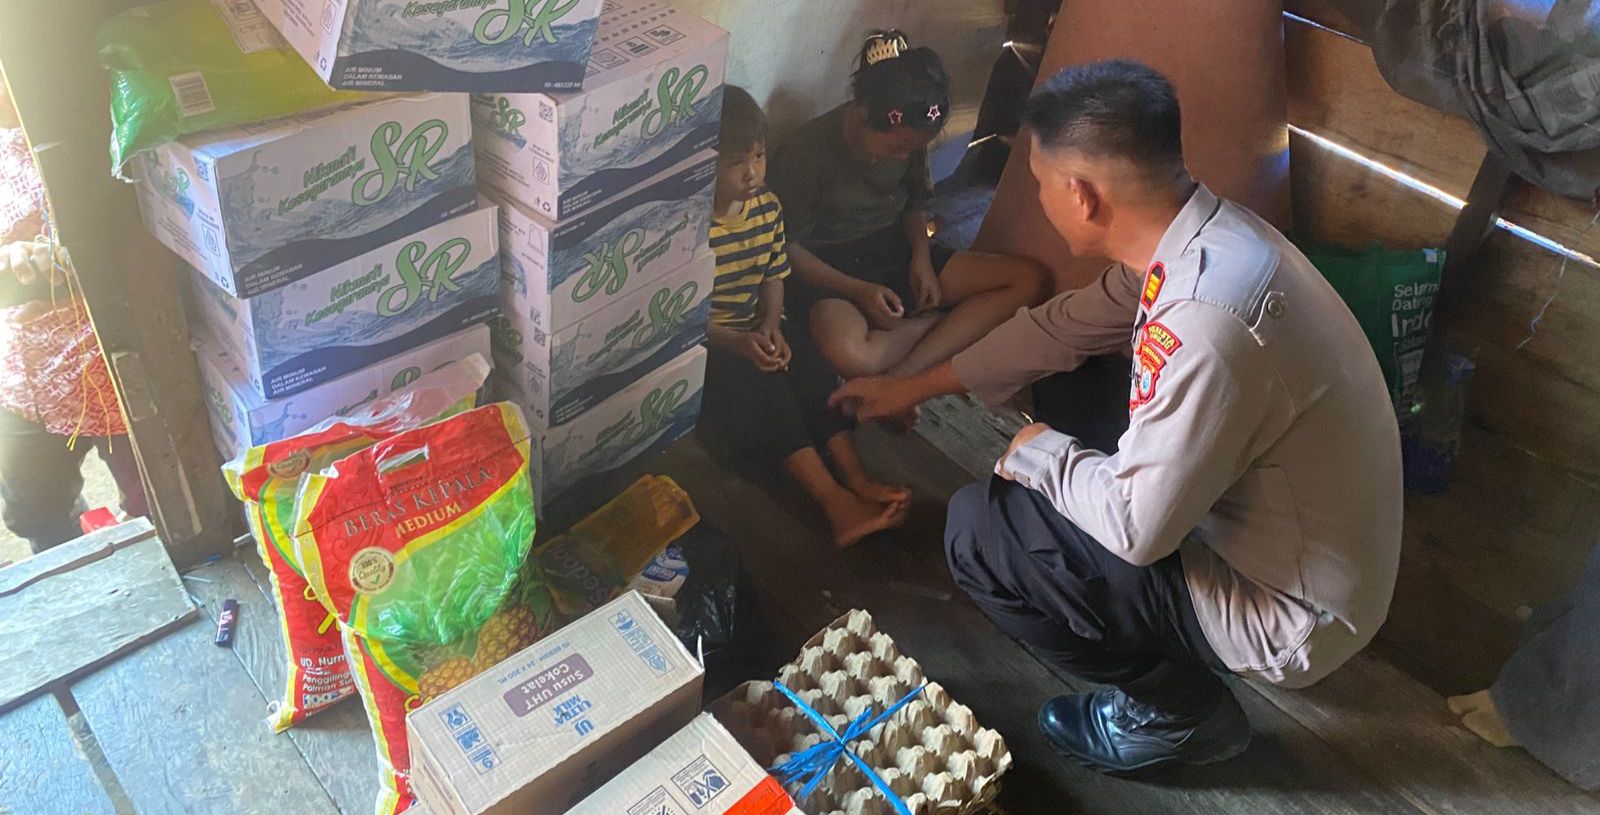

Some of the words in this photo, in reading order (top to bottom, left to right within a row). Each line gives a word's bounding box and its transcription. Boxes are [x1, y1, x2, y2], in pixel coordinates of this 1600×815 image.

[640, 64, 709, 140] SR
[303, 145, 357, 188] Nikmati
[351, 119, 448, 208] SR
[330, 263, 383, 302] Nikmati
[376, 237, 472, 318] SR
[343, 498, 407, 538] BERAS
[395, 500, 463, 539] MEDIUM
[520, 663, 570, 695] Cokelat
[552, 670, 584, 692] Susu
[525, 688, 553, 710] UHT
[553, 694, 582, 716] MILK
[554, 700, 592, 725] ULTRA
